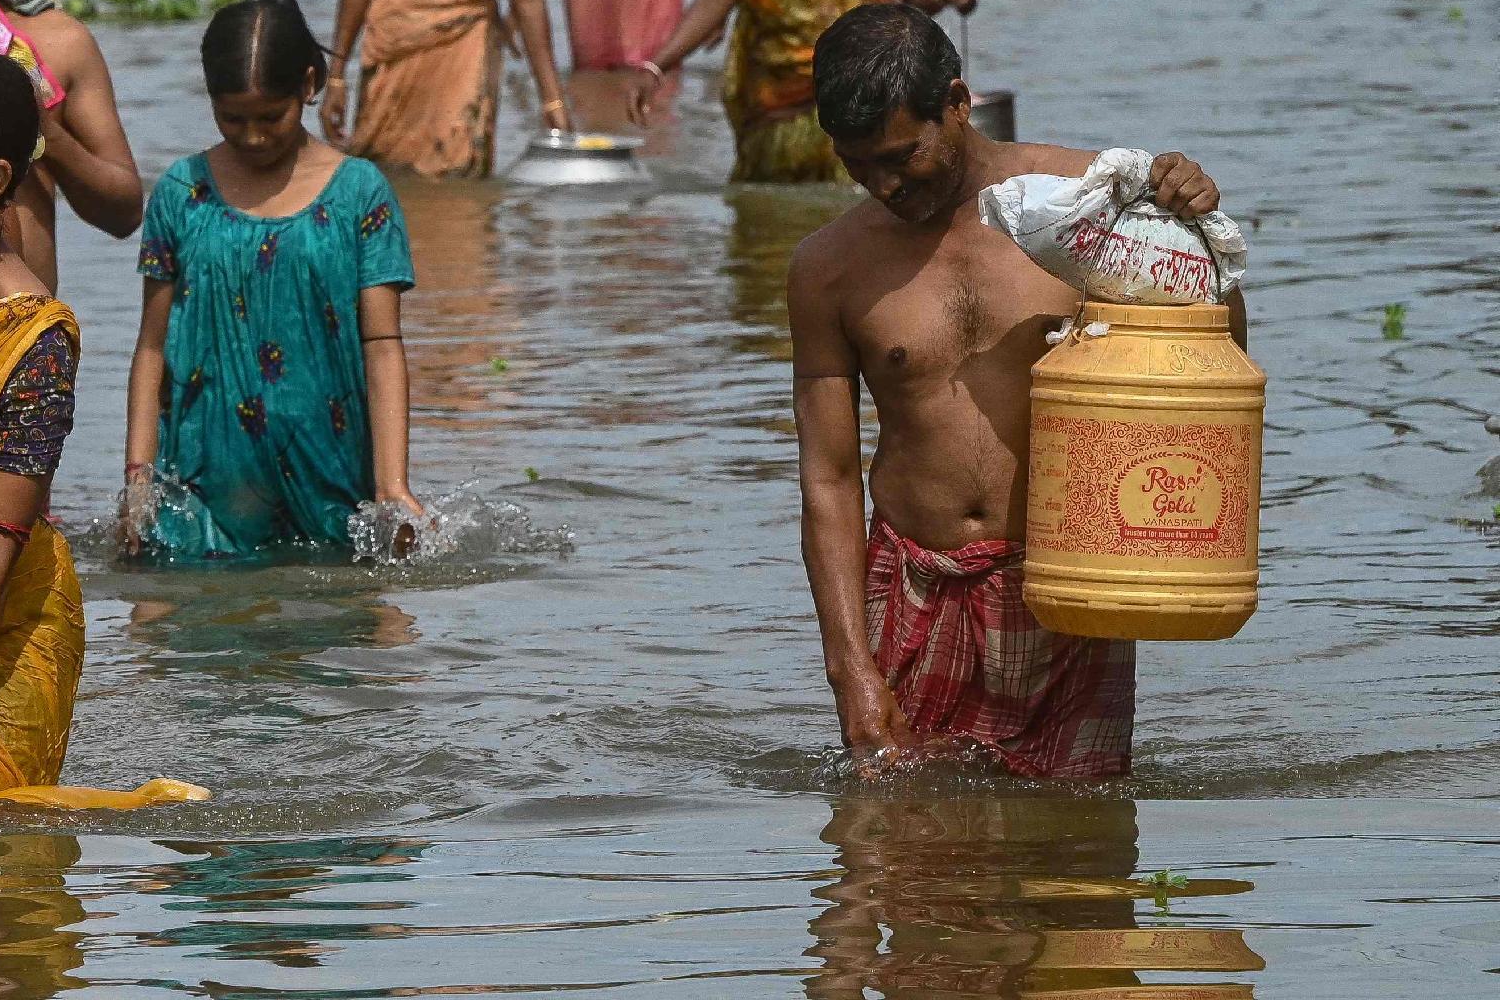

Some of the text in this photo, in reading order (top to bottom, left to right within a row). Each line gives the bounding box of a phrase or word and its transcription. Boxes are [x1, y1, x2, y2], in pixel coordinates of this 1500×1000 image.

[1152, 493, 1196, 518] Gold
[1142, 517, 1204, 528] VANASPATI
[1148, 529, 1157, 538] for
[1158, 530, 1175, 539] more
